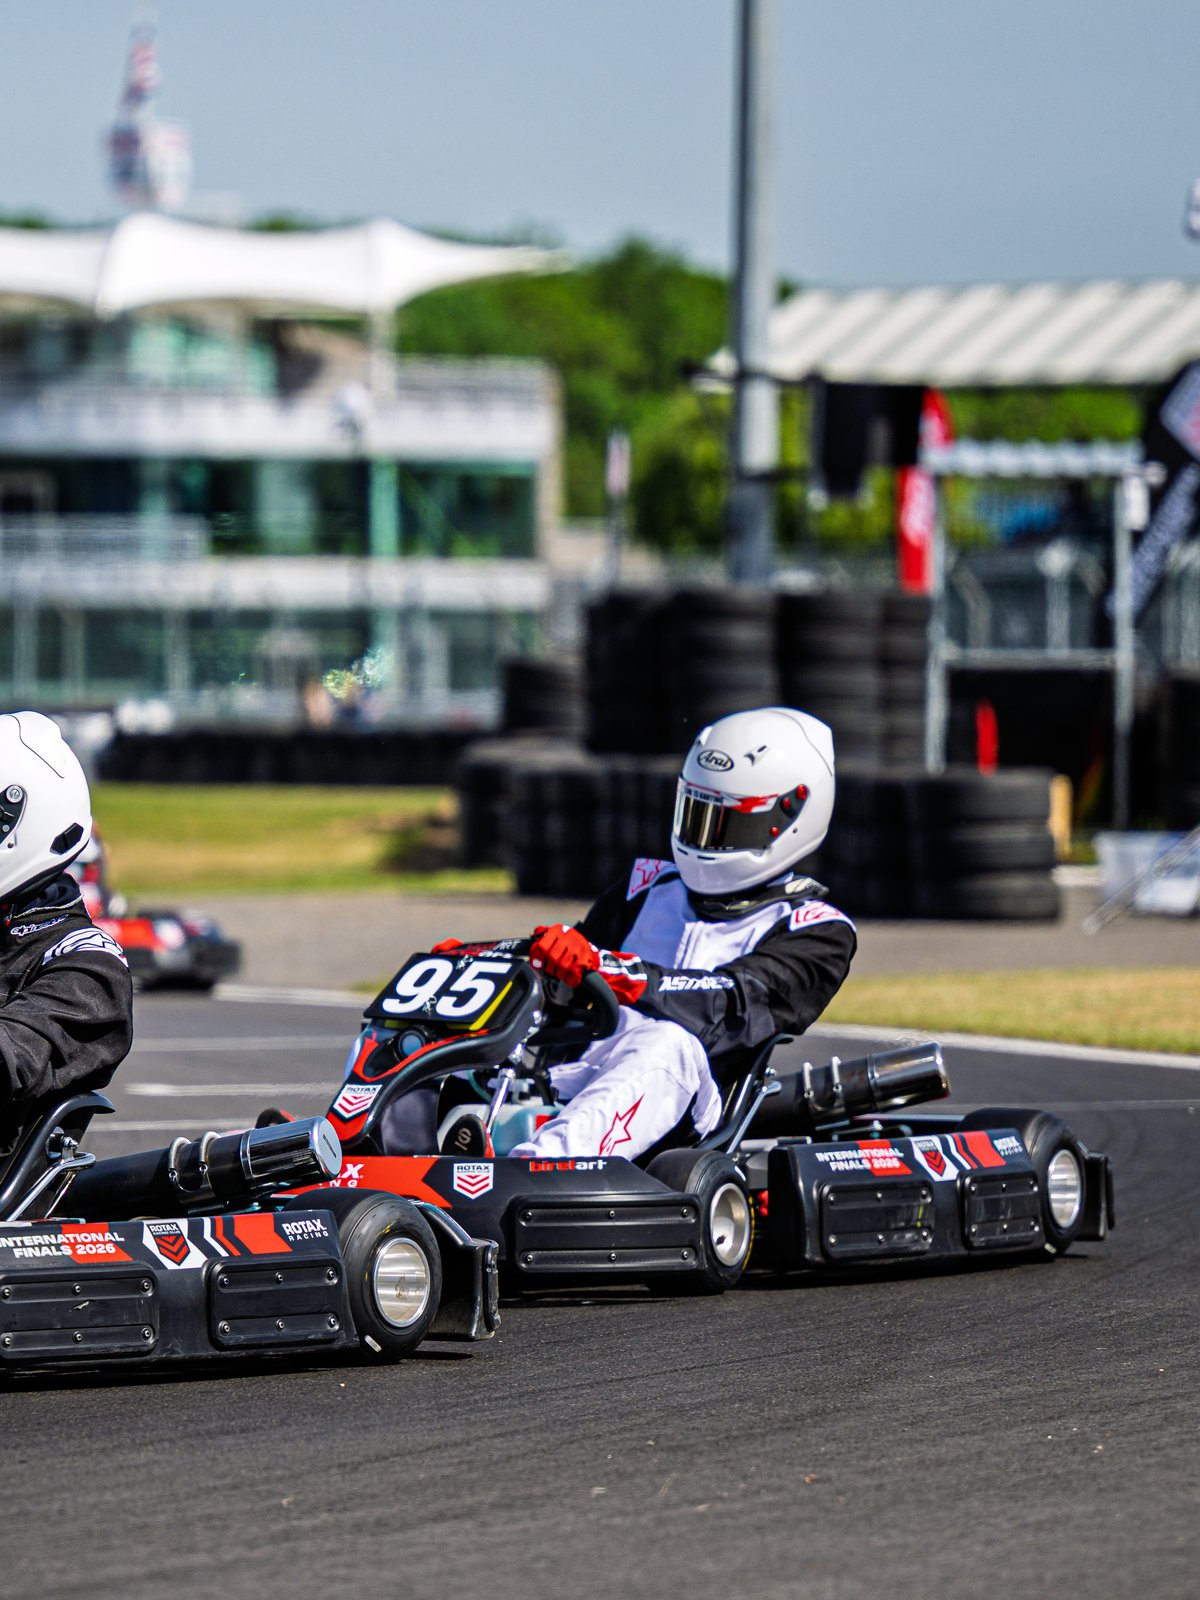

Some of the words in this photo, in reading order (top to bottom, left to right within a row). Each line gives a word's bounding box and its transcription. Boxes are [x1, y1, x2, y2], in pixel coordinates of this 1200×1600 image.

[702, 751, 729, 767] Arai
[382, 958, 512, 1017] 95
[815, 1148, 904, 1162] INTERNATIONAL
[829, 1159, 872, 1171] FINALS
[149, 1224, 179, 1232] ROTAX
[282, 1219, 326, 1235] ROTAX
[288, 1230, 329, 1242] RACING
[13, 1245, 72, 1258] FINALS
[76, 1244, 116, 1254] 2026
